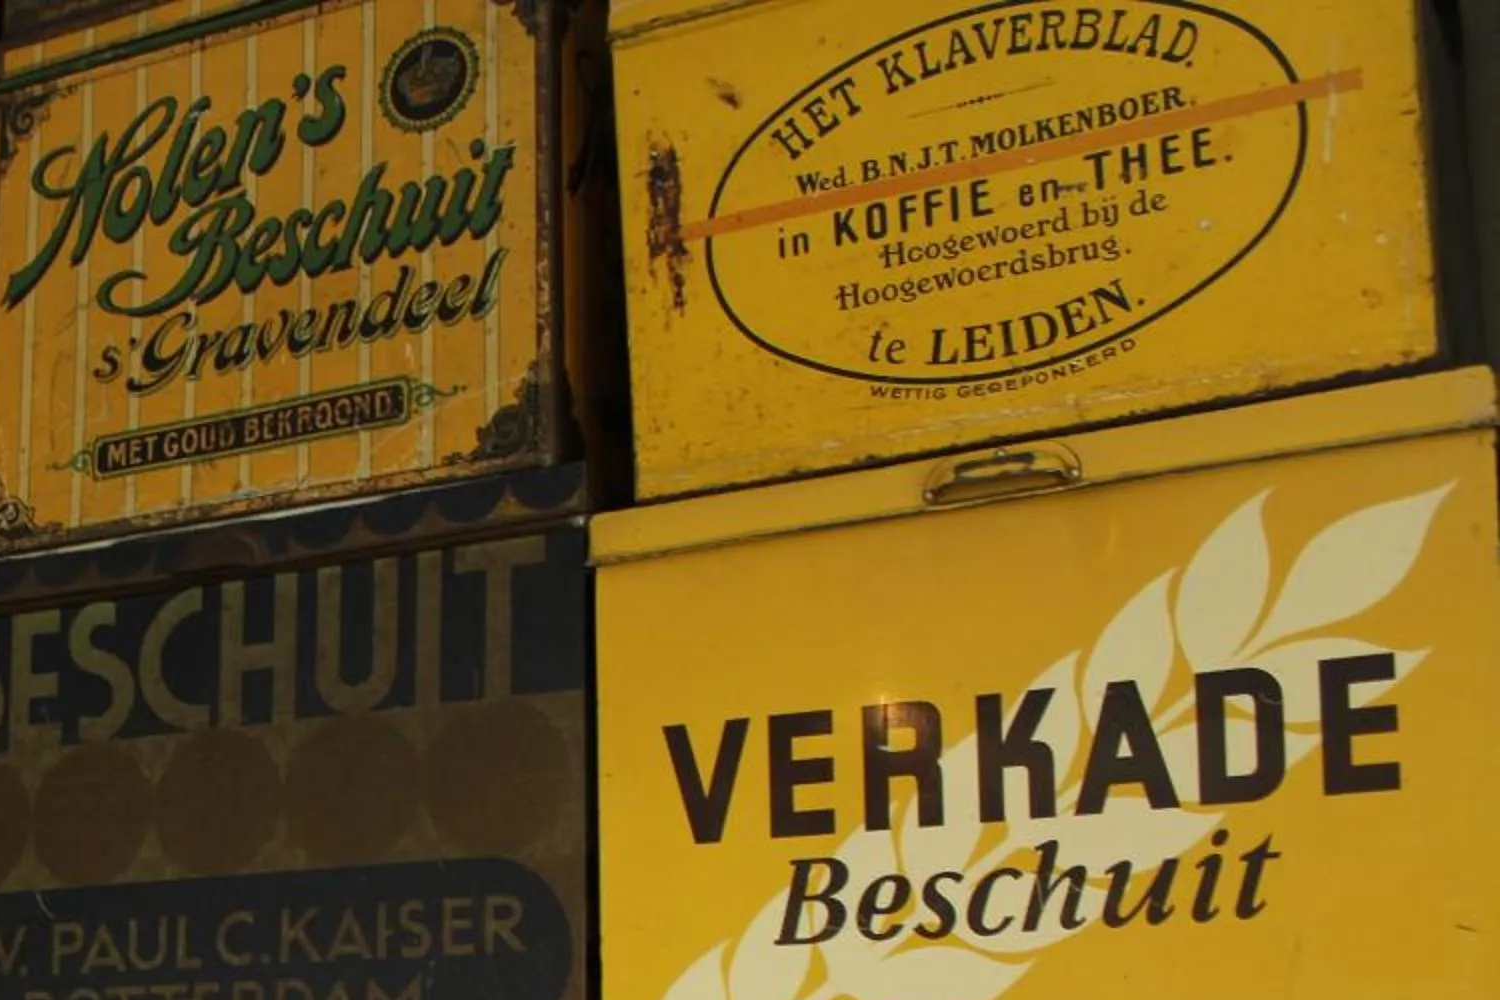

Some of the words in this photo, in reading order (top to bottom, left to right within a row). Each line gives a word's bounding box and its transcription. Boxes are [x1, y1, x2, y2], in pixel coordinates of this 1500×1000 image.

[771, 78, 863, 159] HET
[2, 65, 346, 311] Nolen's
[777, 228, 810, 259] in
[833, 179, 994, 247] KOFFIE
[1018, 179, 1060, 207] en
[796, 173, 853, 197] Wed.
[96, 138, 515, 315] Beschuit
[880, 206, 1070, 269] Hoogewoerd
[1082, 197, 1120, 228] bij
[1128, 190, 1169, 216] de
[868, 330, 906, 364] te
[870, 385, 946, 399] WETTIG
[106, 439, 160, 470] MET
[162, 424, 233, 457] GOUD
[663, 652, 1402, 844] VERKADE
[774, 830, 1281, 946] Beschuit
[52, 915, 202, 977] PAUL
